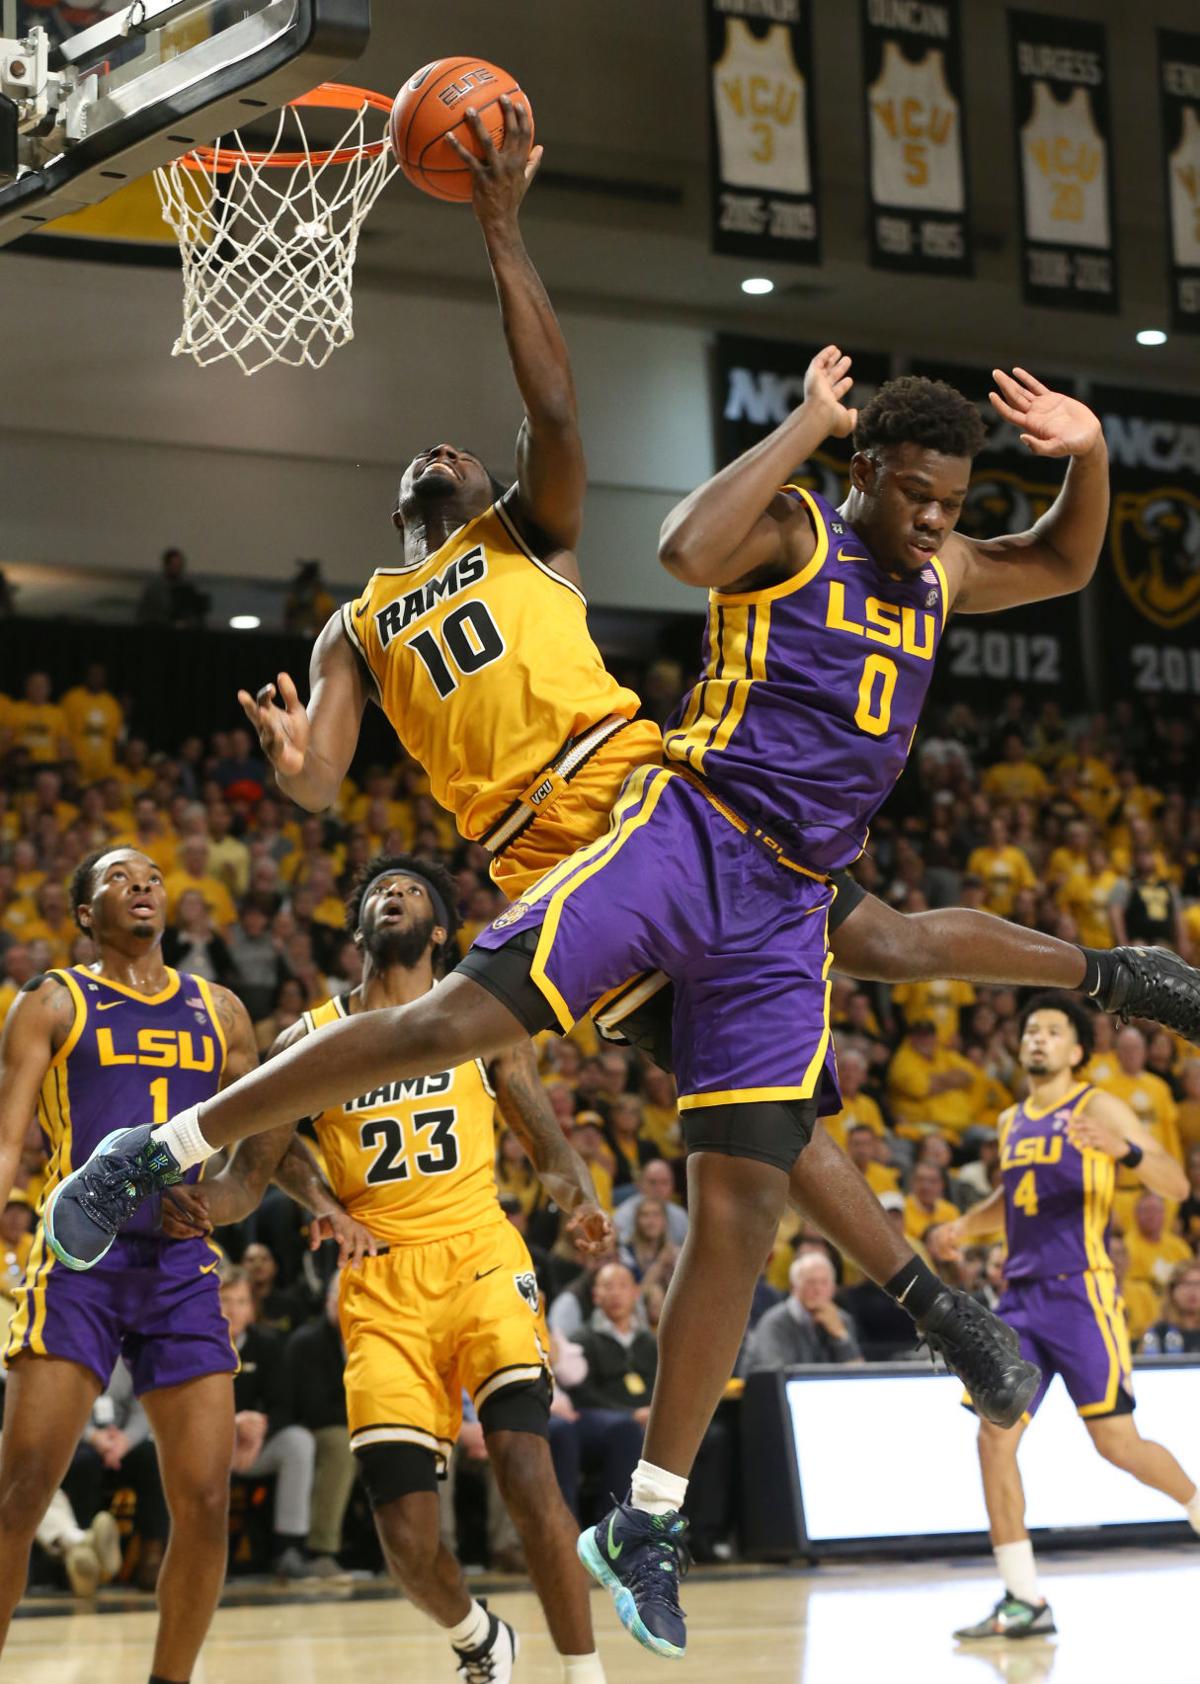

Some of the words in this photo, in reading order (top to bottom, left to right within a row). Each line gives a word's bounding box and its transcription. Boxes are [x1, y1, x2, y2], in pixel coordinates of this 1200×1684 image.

[721, 76, 799, 127] VCU
[874, 98, 958, 146] VCU
[752, 123, 775, 165] 3
[904, 145, 928, 188] 5
[1030, 136, 1101, 183] VCU
[373, 542, 489, 652] RAMS
[825, 580, 935, 661] LSU
[404, 598, 508, 701] 10
[948, 628, 1060, 684] 2012
[854, 653, 898, 737] 0
[530, 779, 554, 806] VCU
[95, 1027, 215, 1074] LSU
[149, 1077, 168, 1124] 1
[360, 1105, 460, 1187] 23
[1000, 1135, 1064, 1171] LSU
[1013, 1168, 1038, 1216] 4
